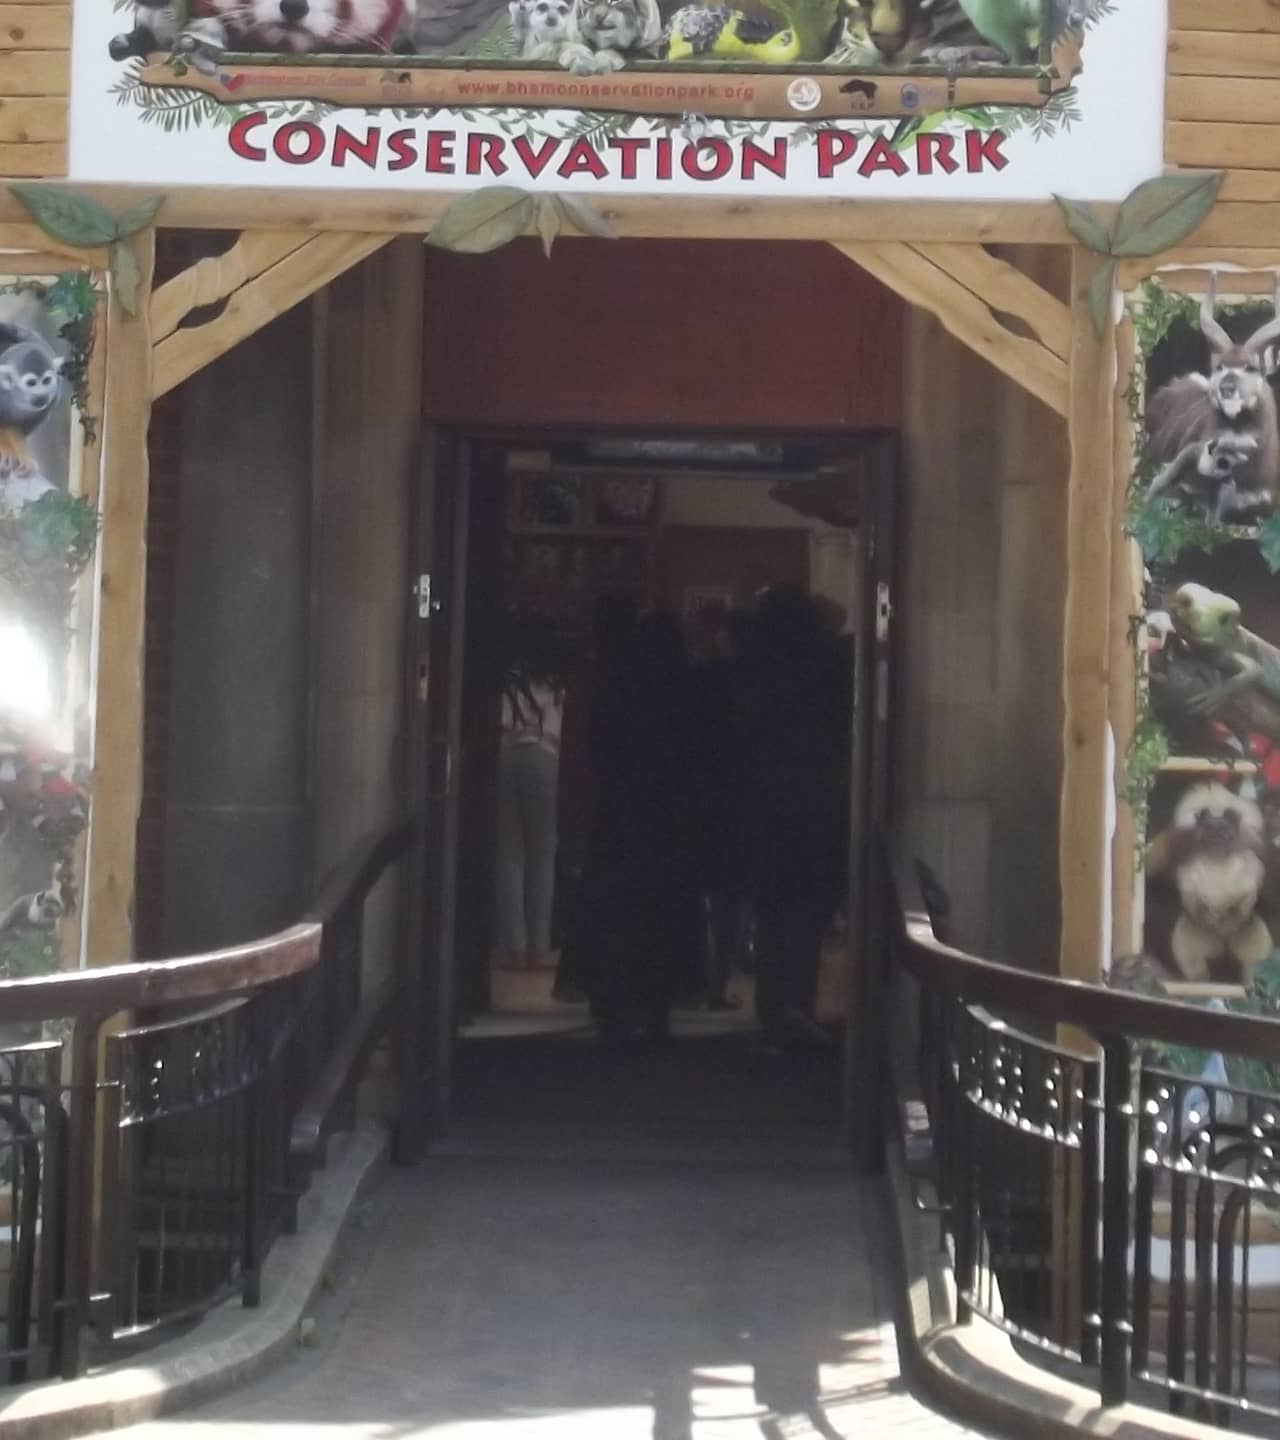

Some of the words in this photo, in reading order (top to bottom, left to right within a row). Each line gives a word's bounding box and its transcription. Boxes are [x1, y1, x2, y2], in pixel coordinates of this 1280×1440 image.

[457, 81, 754, 101] www.bhamconservationpark.org
[227, 111, 787, 180] CONSERVATION
[815, 127, 1011, 178] PARK
